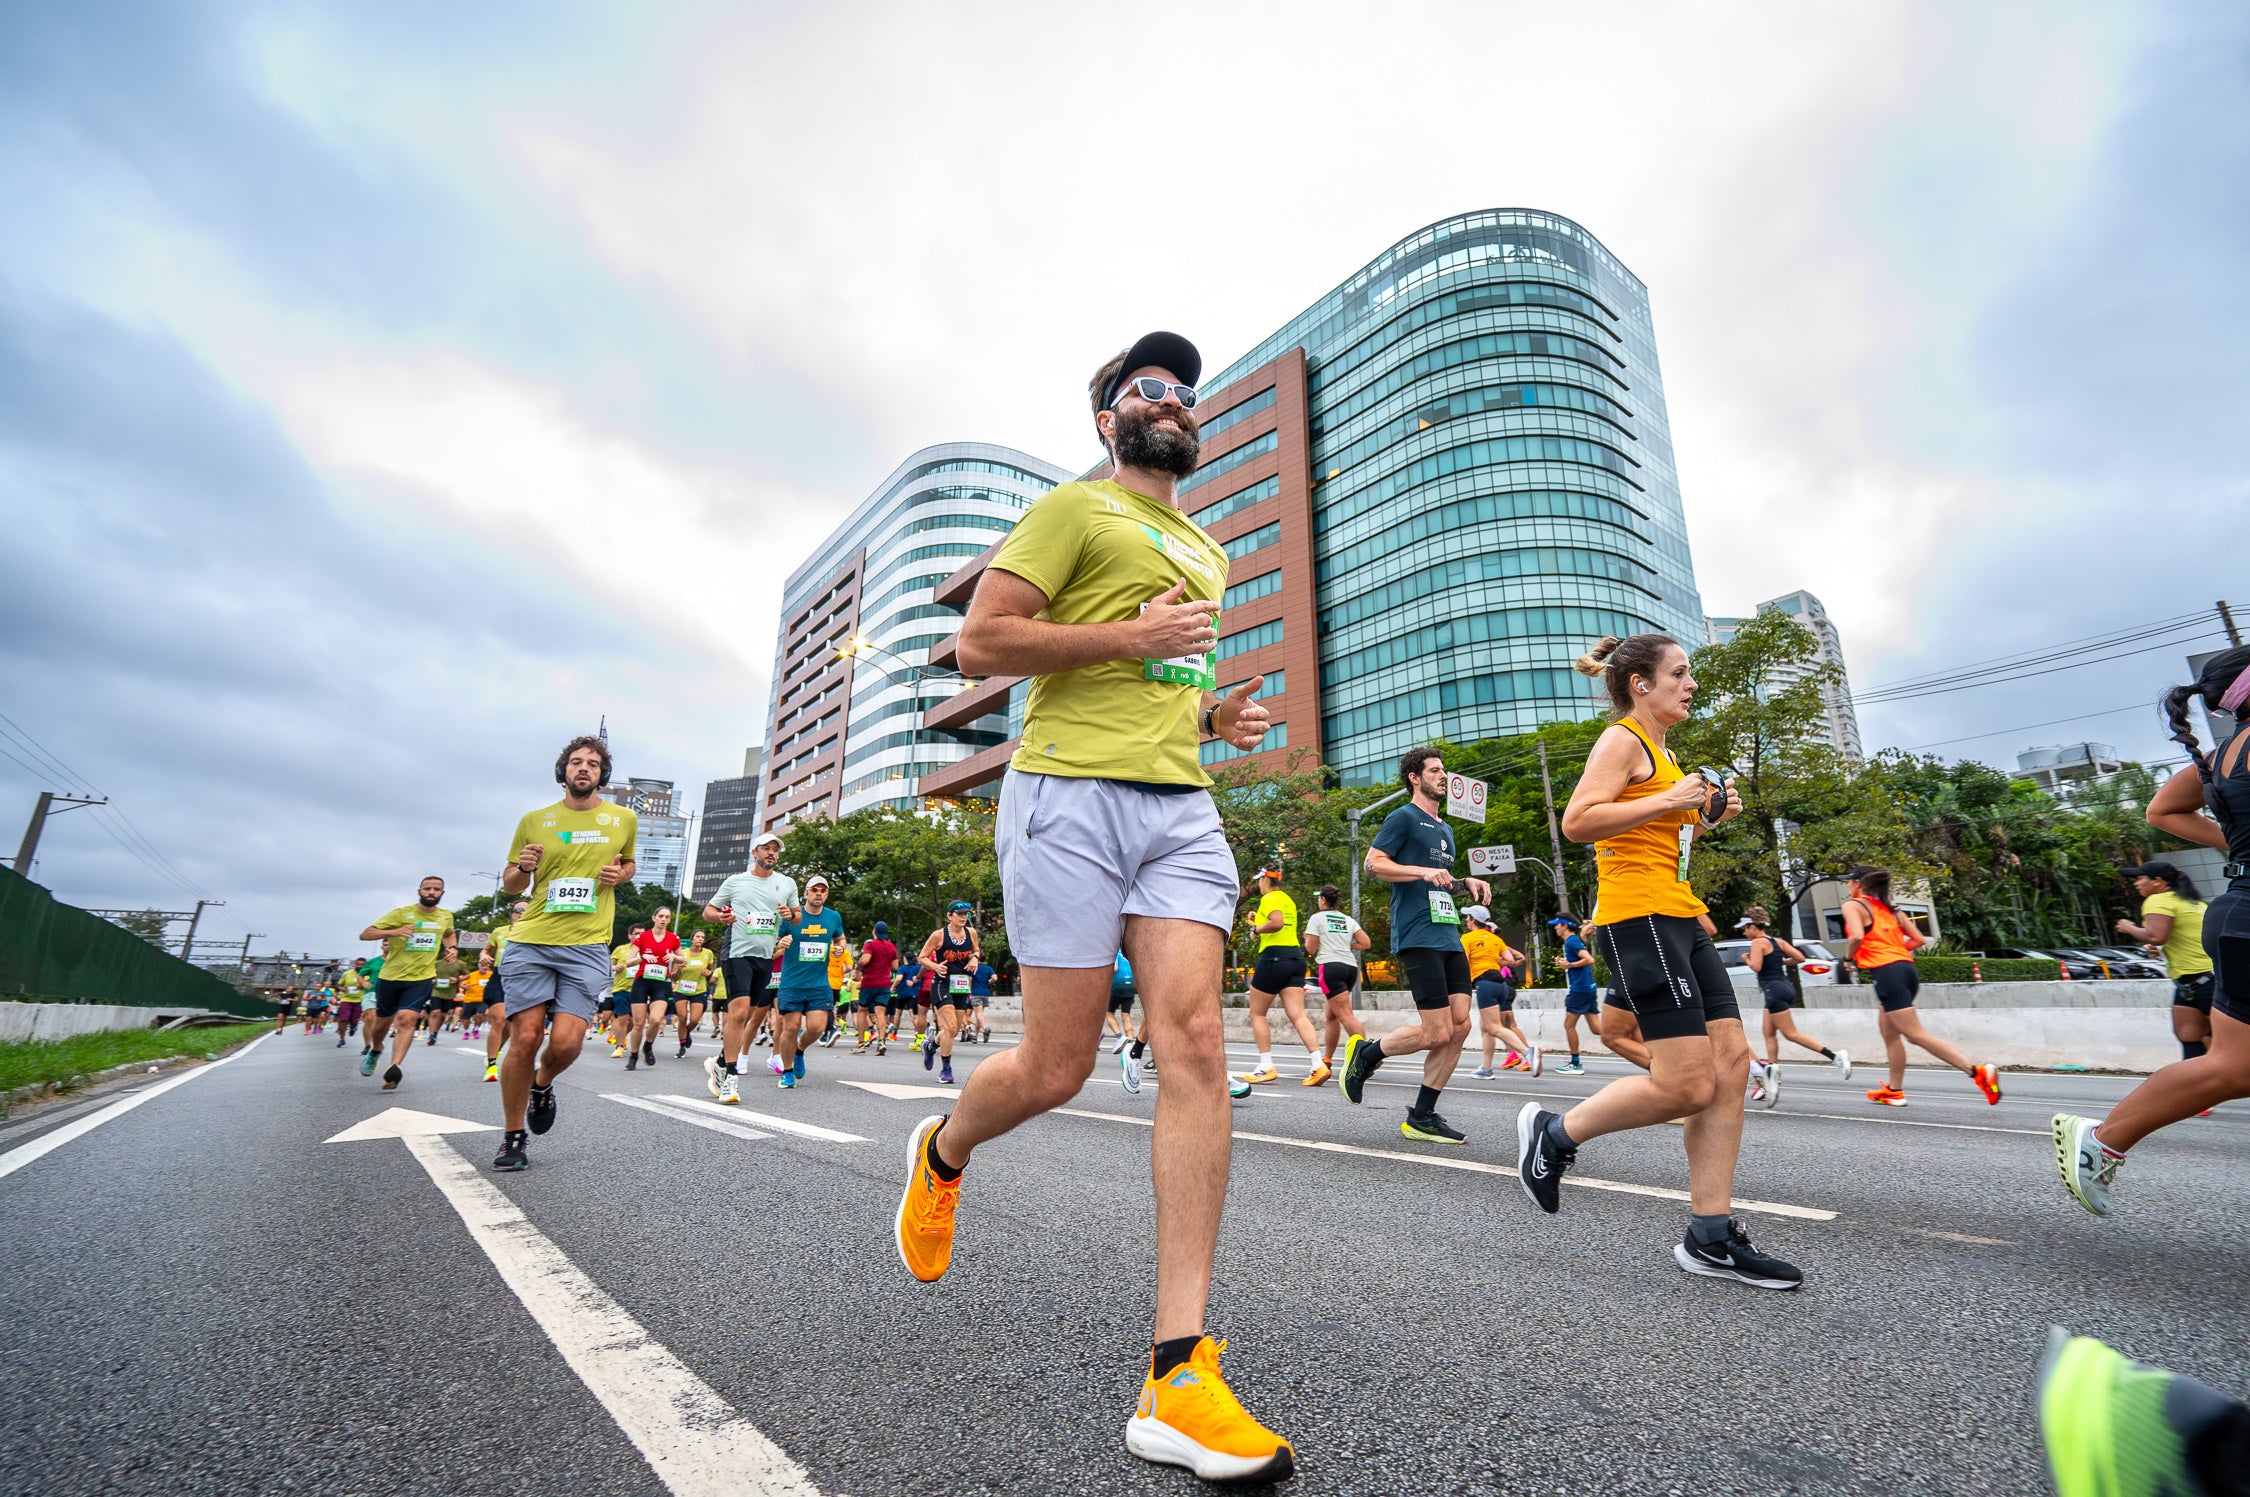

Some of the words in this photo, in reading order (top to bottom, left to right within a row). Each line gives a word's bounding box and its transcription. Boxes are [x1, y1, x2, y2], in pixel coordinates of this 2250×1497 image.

[1454, 781, 1462, 791] 60
[558, 887, 589, 898] 8437
[756, 918, 773, 926] 7275
[1677, 976, 1692, 997] GRIT
